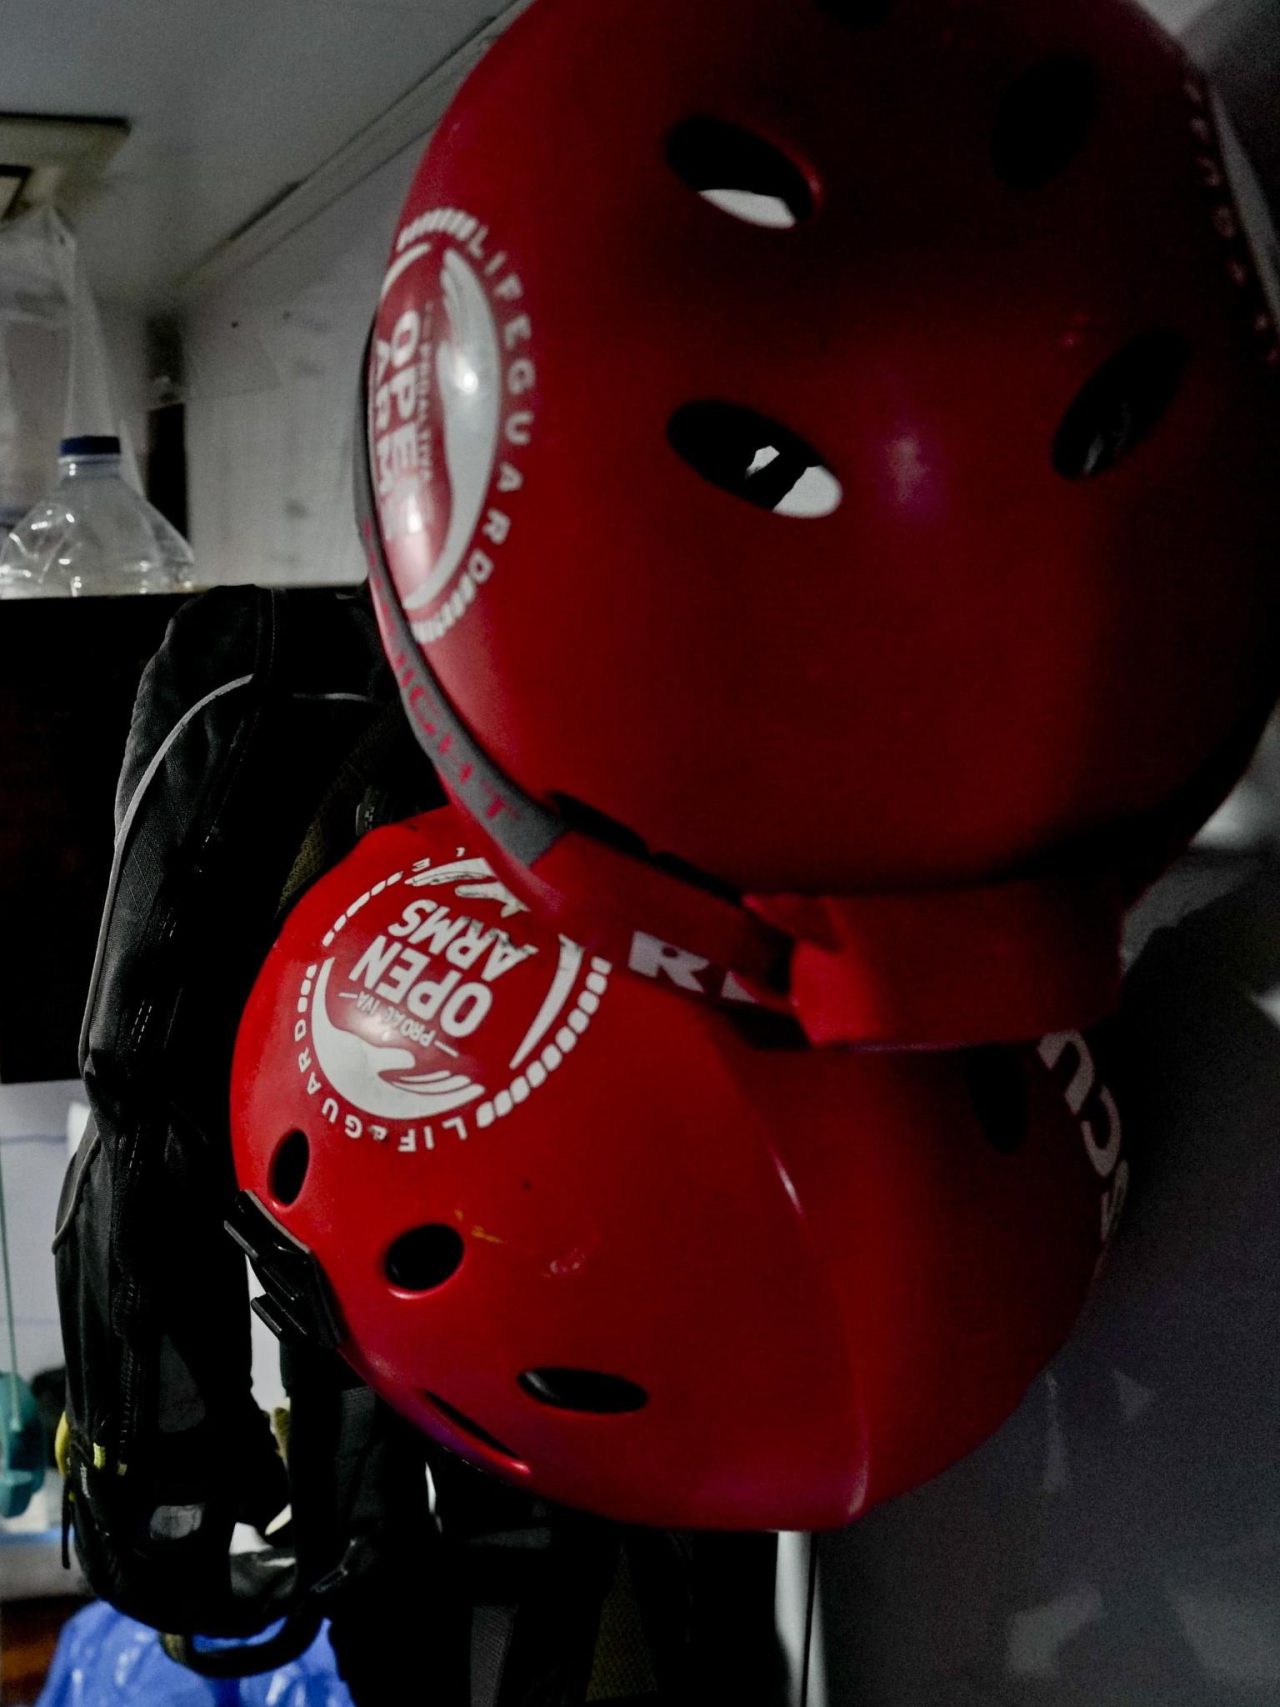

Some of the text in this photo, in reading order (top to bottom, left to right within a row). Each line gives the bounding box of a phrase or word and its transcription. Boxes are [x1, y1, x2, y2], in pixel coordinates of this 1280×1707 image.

[469, 224, 537, 583] LIFEGUARD
[349, 934, 492, 1038] OPEN
[388, 899, 538, 982] ARMS
[357, 991, 435, 1047] PROACIVA
